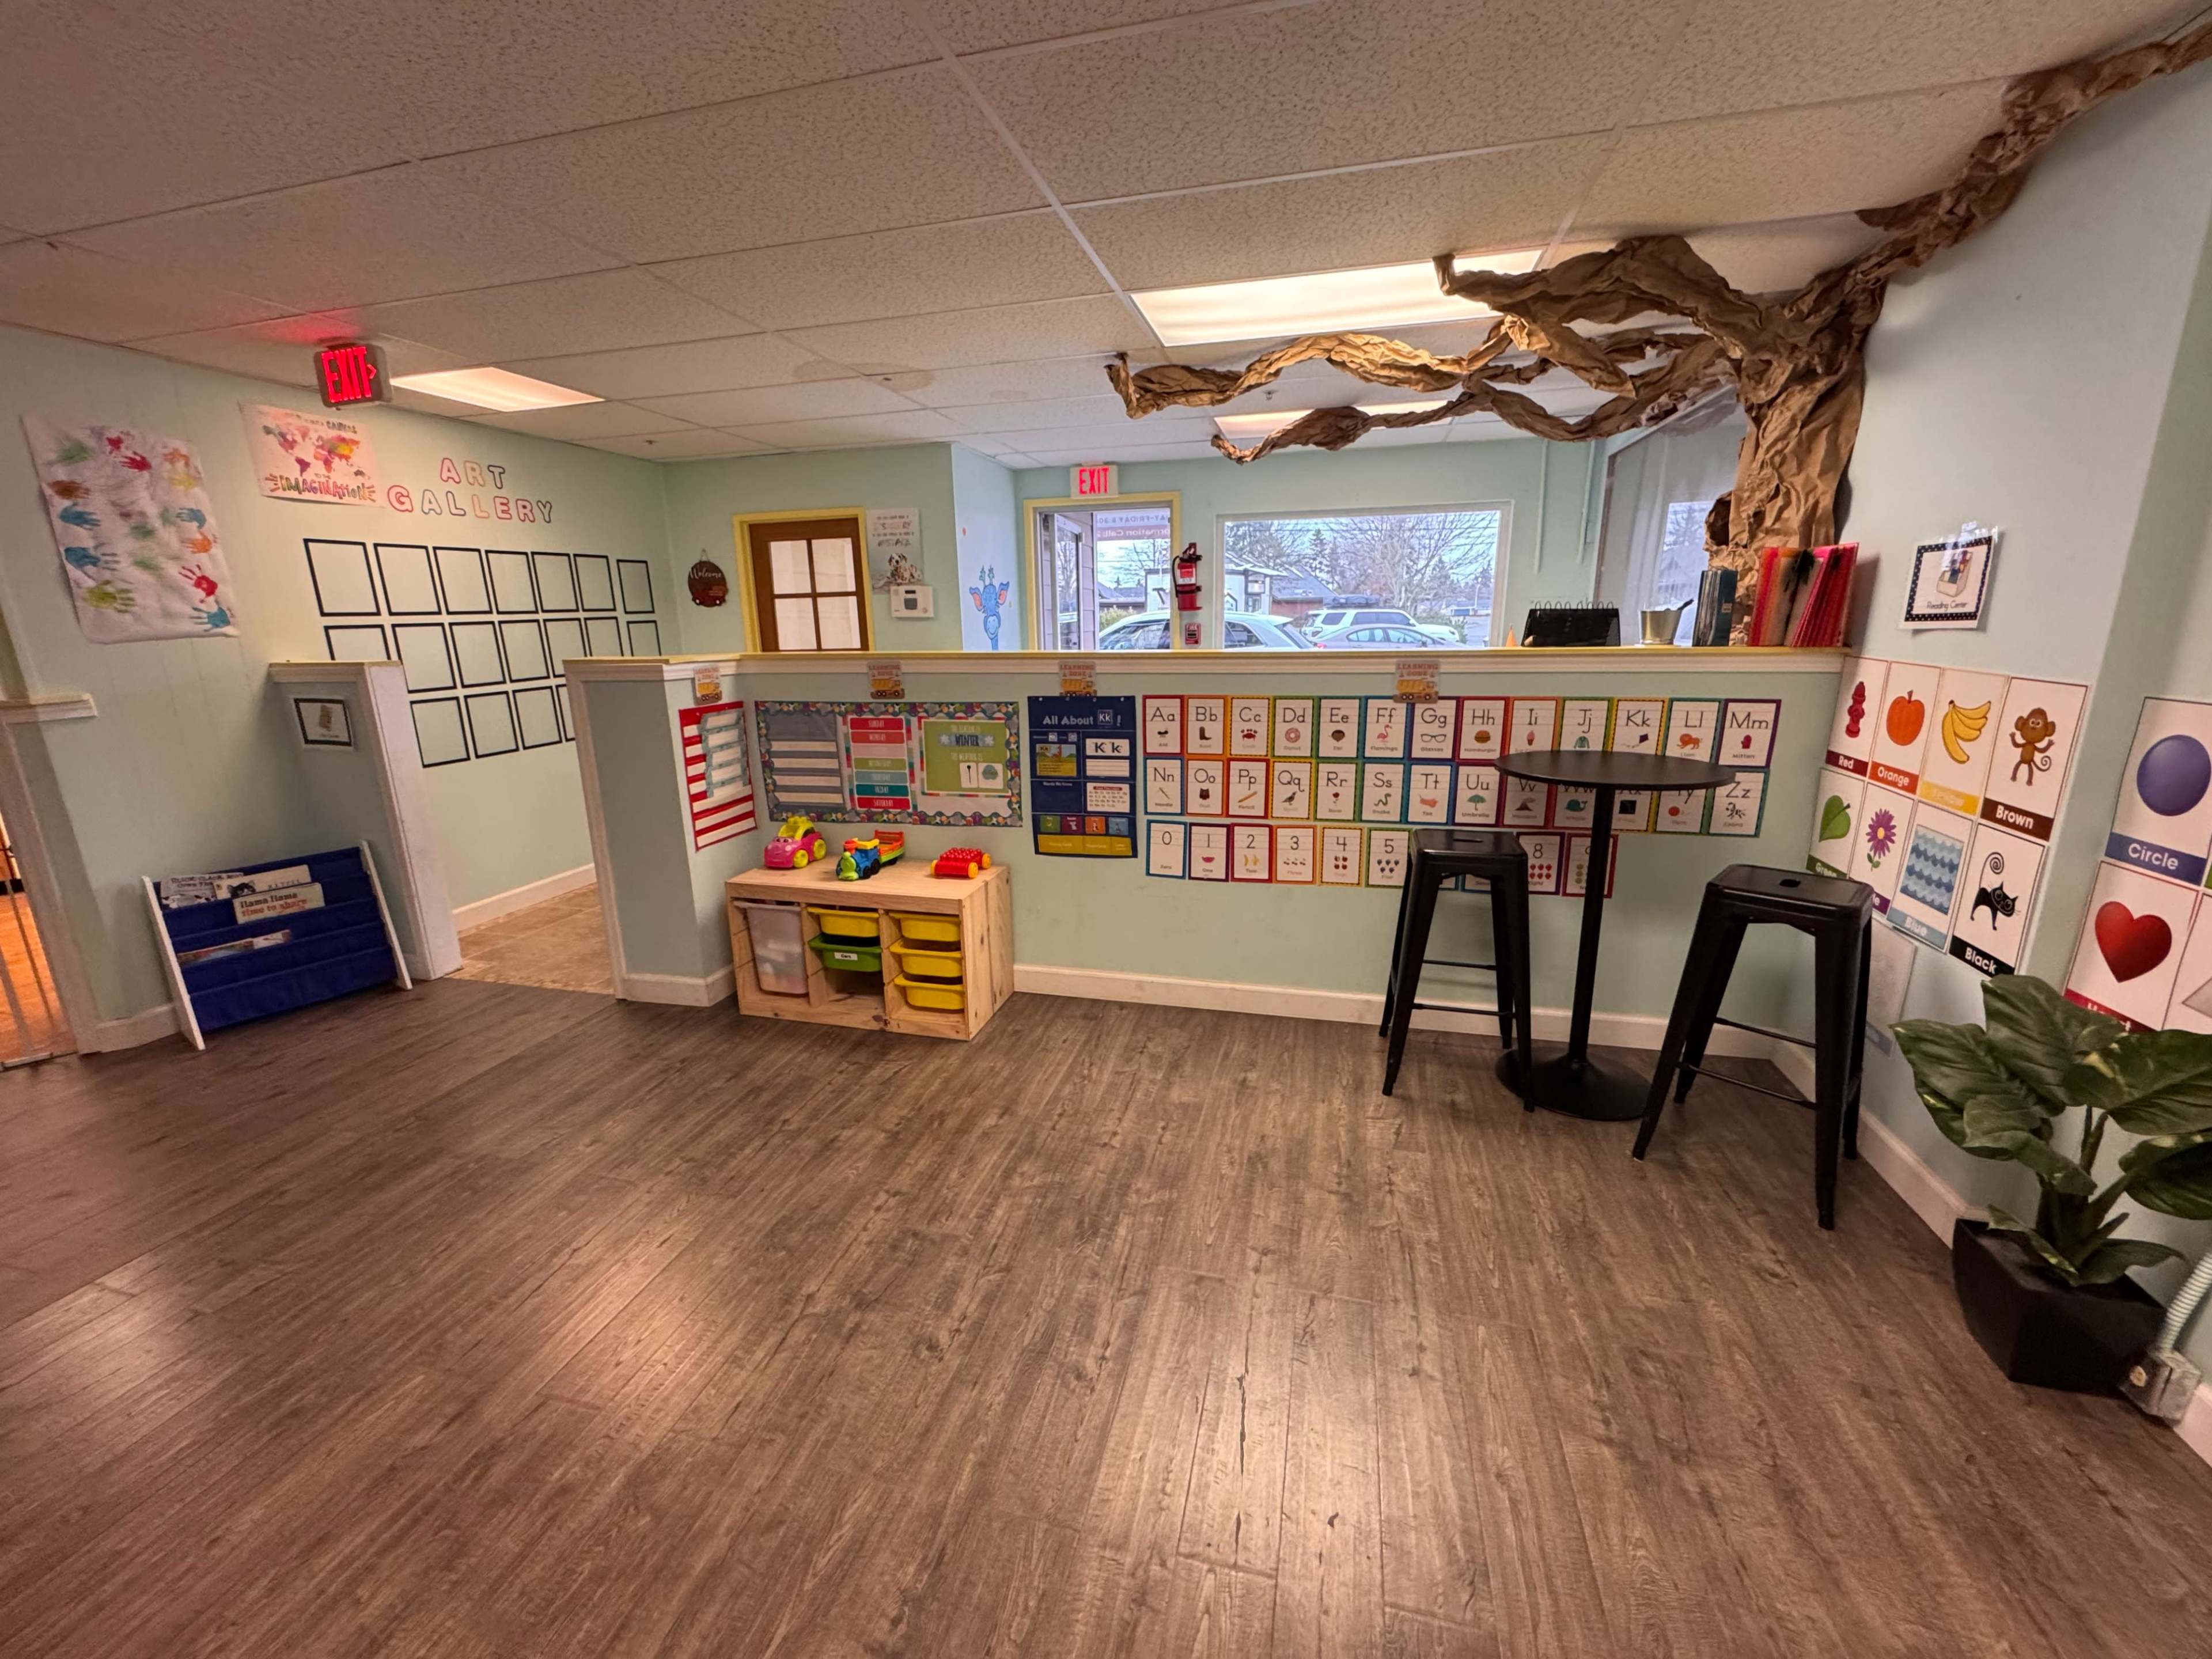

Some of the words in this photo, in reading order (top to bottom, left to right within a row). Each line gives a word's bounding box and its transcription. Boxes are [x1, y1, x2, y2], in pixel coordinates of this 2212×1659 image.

[321, 346, 372, 403] EXIT
[440, 457, 505, 489] ART
[1078, 467, 1109, 495] EXIT
[387, 485, 552, 523] GALLERY
[690, 567, 722, 579] Welcome
[1926, 601, 1949, 611] Reading
[1950, 600, 1968, 609] Center
[1043, 715, 1058, 725] All
[1061, 715, 1093, 725] About
[1099, 713, 1111, 722] Kk
[1150, 707, 1175, 721] Aa
[1196, 706, 1218, 721] Bb
[1239, 707, 1261, 722] Cc
[1283, 707, 1305, 723] Dd
[1330, 707, 1349, 723] Ee
[1376, 707, 1396, 724] Ff
[1421, 707, 1447, 728] Gg
[1471, 709, 1495, 725] Hh
[1528, 708, 1538, 725] Ii
[1577, 709, 1592, 734] Jj
[1626, 710, 1650, 727] Kk
[1729, 711, 1769, 729] Mm
[955, 734, 979, 747] WINTER
[1838, 755, 1854, 770] Red
[1153, 767, 1174, 782] Nn
[1194, 768, 1215, 783] Oo
[1238, 769, 1257, 791] Pp
[1278, 770, 1305, 792] Qq
[1326, 771, 1347, 787] Rr
[1373, 772, 1392, 788] Ss
[1421, 774, 1439, 789] Tt
[1467, 774, 1490, 790] Uu
[1877, 768, 1910, 787] Orange
[1726, 782, 1751, 798] Zz
[1996, 805, 2035, 830] Brown
[1162, 831, 1172, 845] 0
[1247, 834, 1255, 849] 2
[1290, 835, 1299, 850] 3
[1336, 836, 1347, 851] 4
[1385, 839, 1394, 854] 5
[1533, 843, 1543, 858] 8
[2128, 843, 2179, 870] Circle
[1904, 916, 1928, 937] Blue
[1964, 946, 1998, 975] Black
